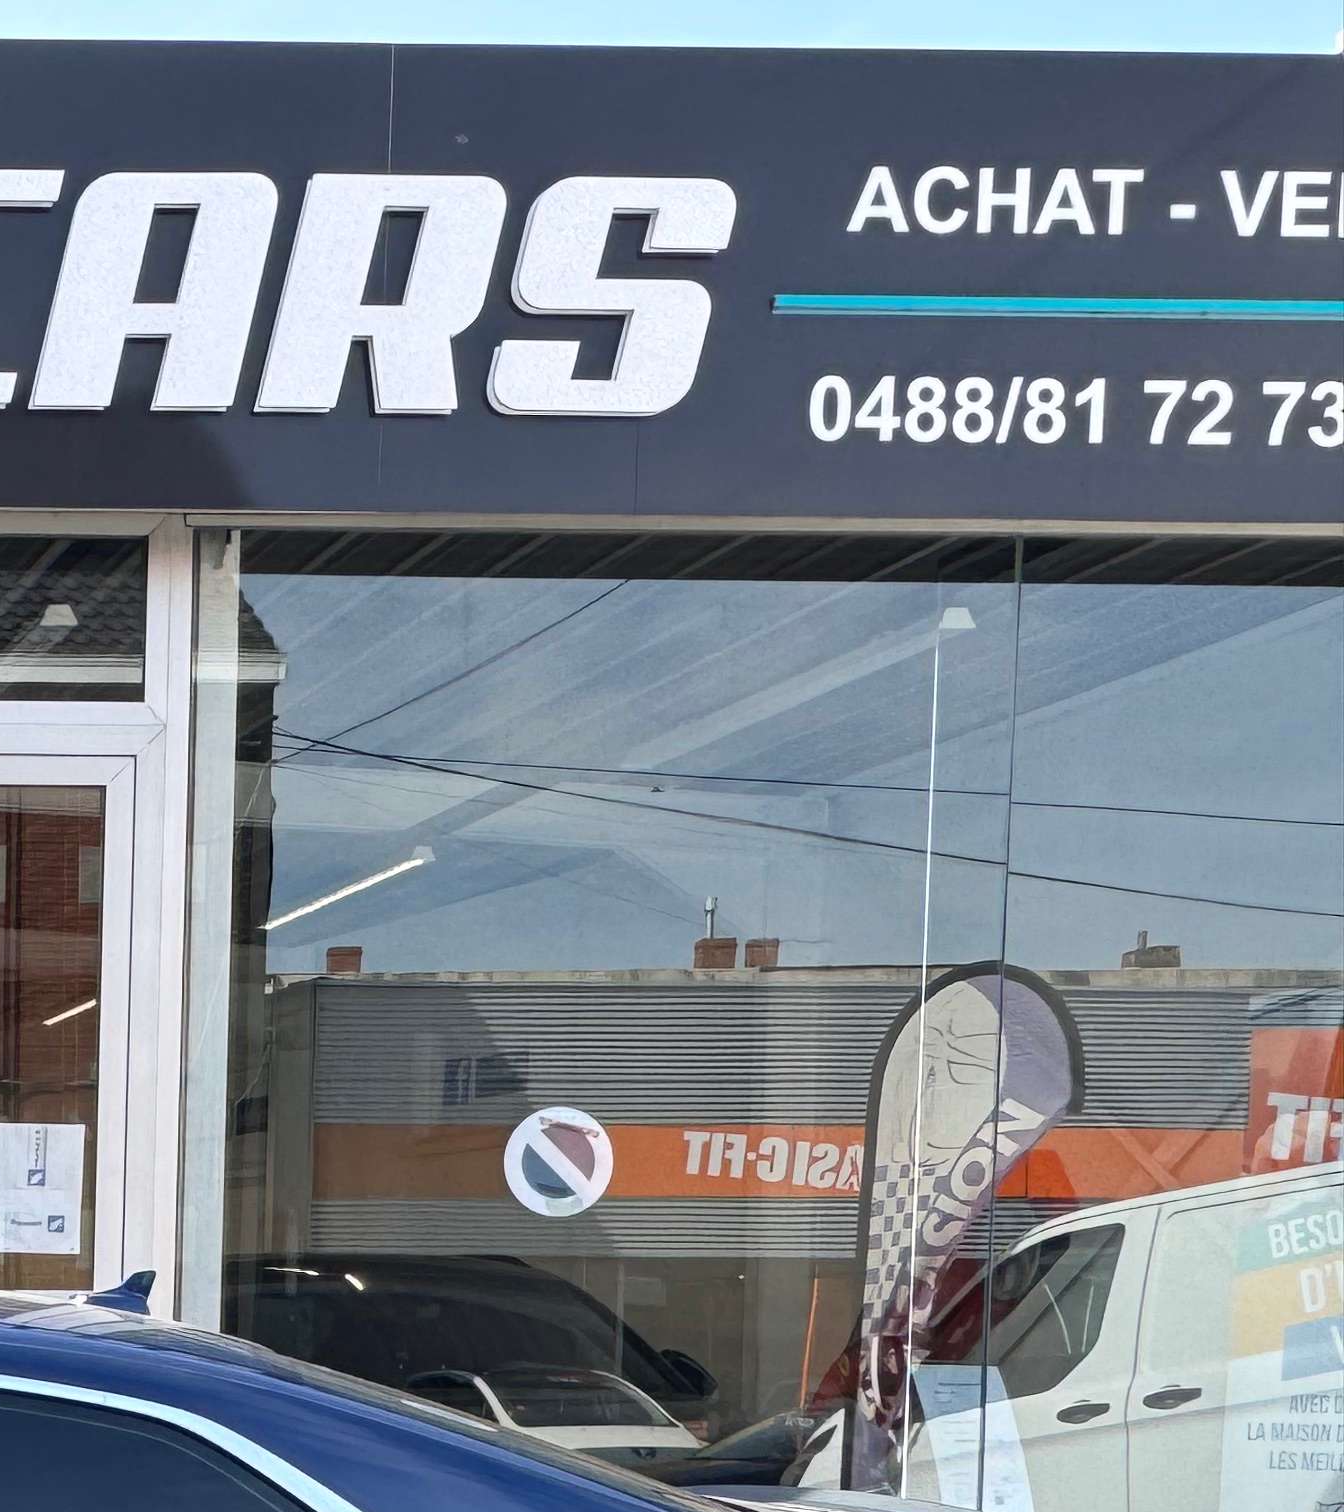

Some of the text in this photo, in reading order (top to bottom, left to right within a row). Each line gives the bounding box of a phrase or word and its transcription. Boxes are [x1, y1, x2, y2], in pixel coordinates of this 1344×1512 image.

[847, 166, 1144, 236] ACHAT
[1220, 170, 1344, 239] VE
[810, 375, 1344, 448] 0488/81 72 73
[1289, 1393, 1330, 1414] AVEC
[1247, 1422, 1265, 1441] LA
[1271, 1422, 1332, 1441] MAISON
[1269, 1450, 1297, 1470] LES
